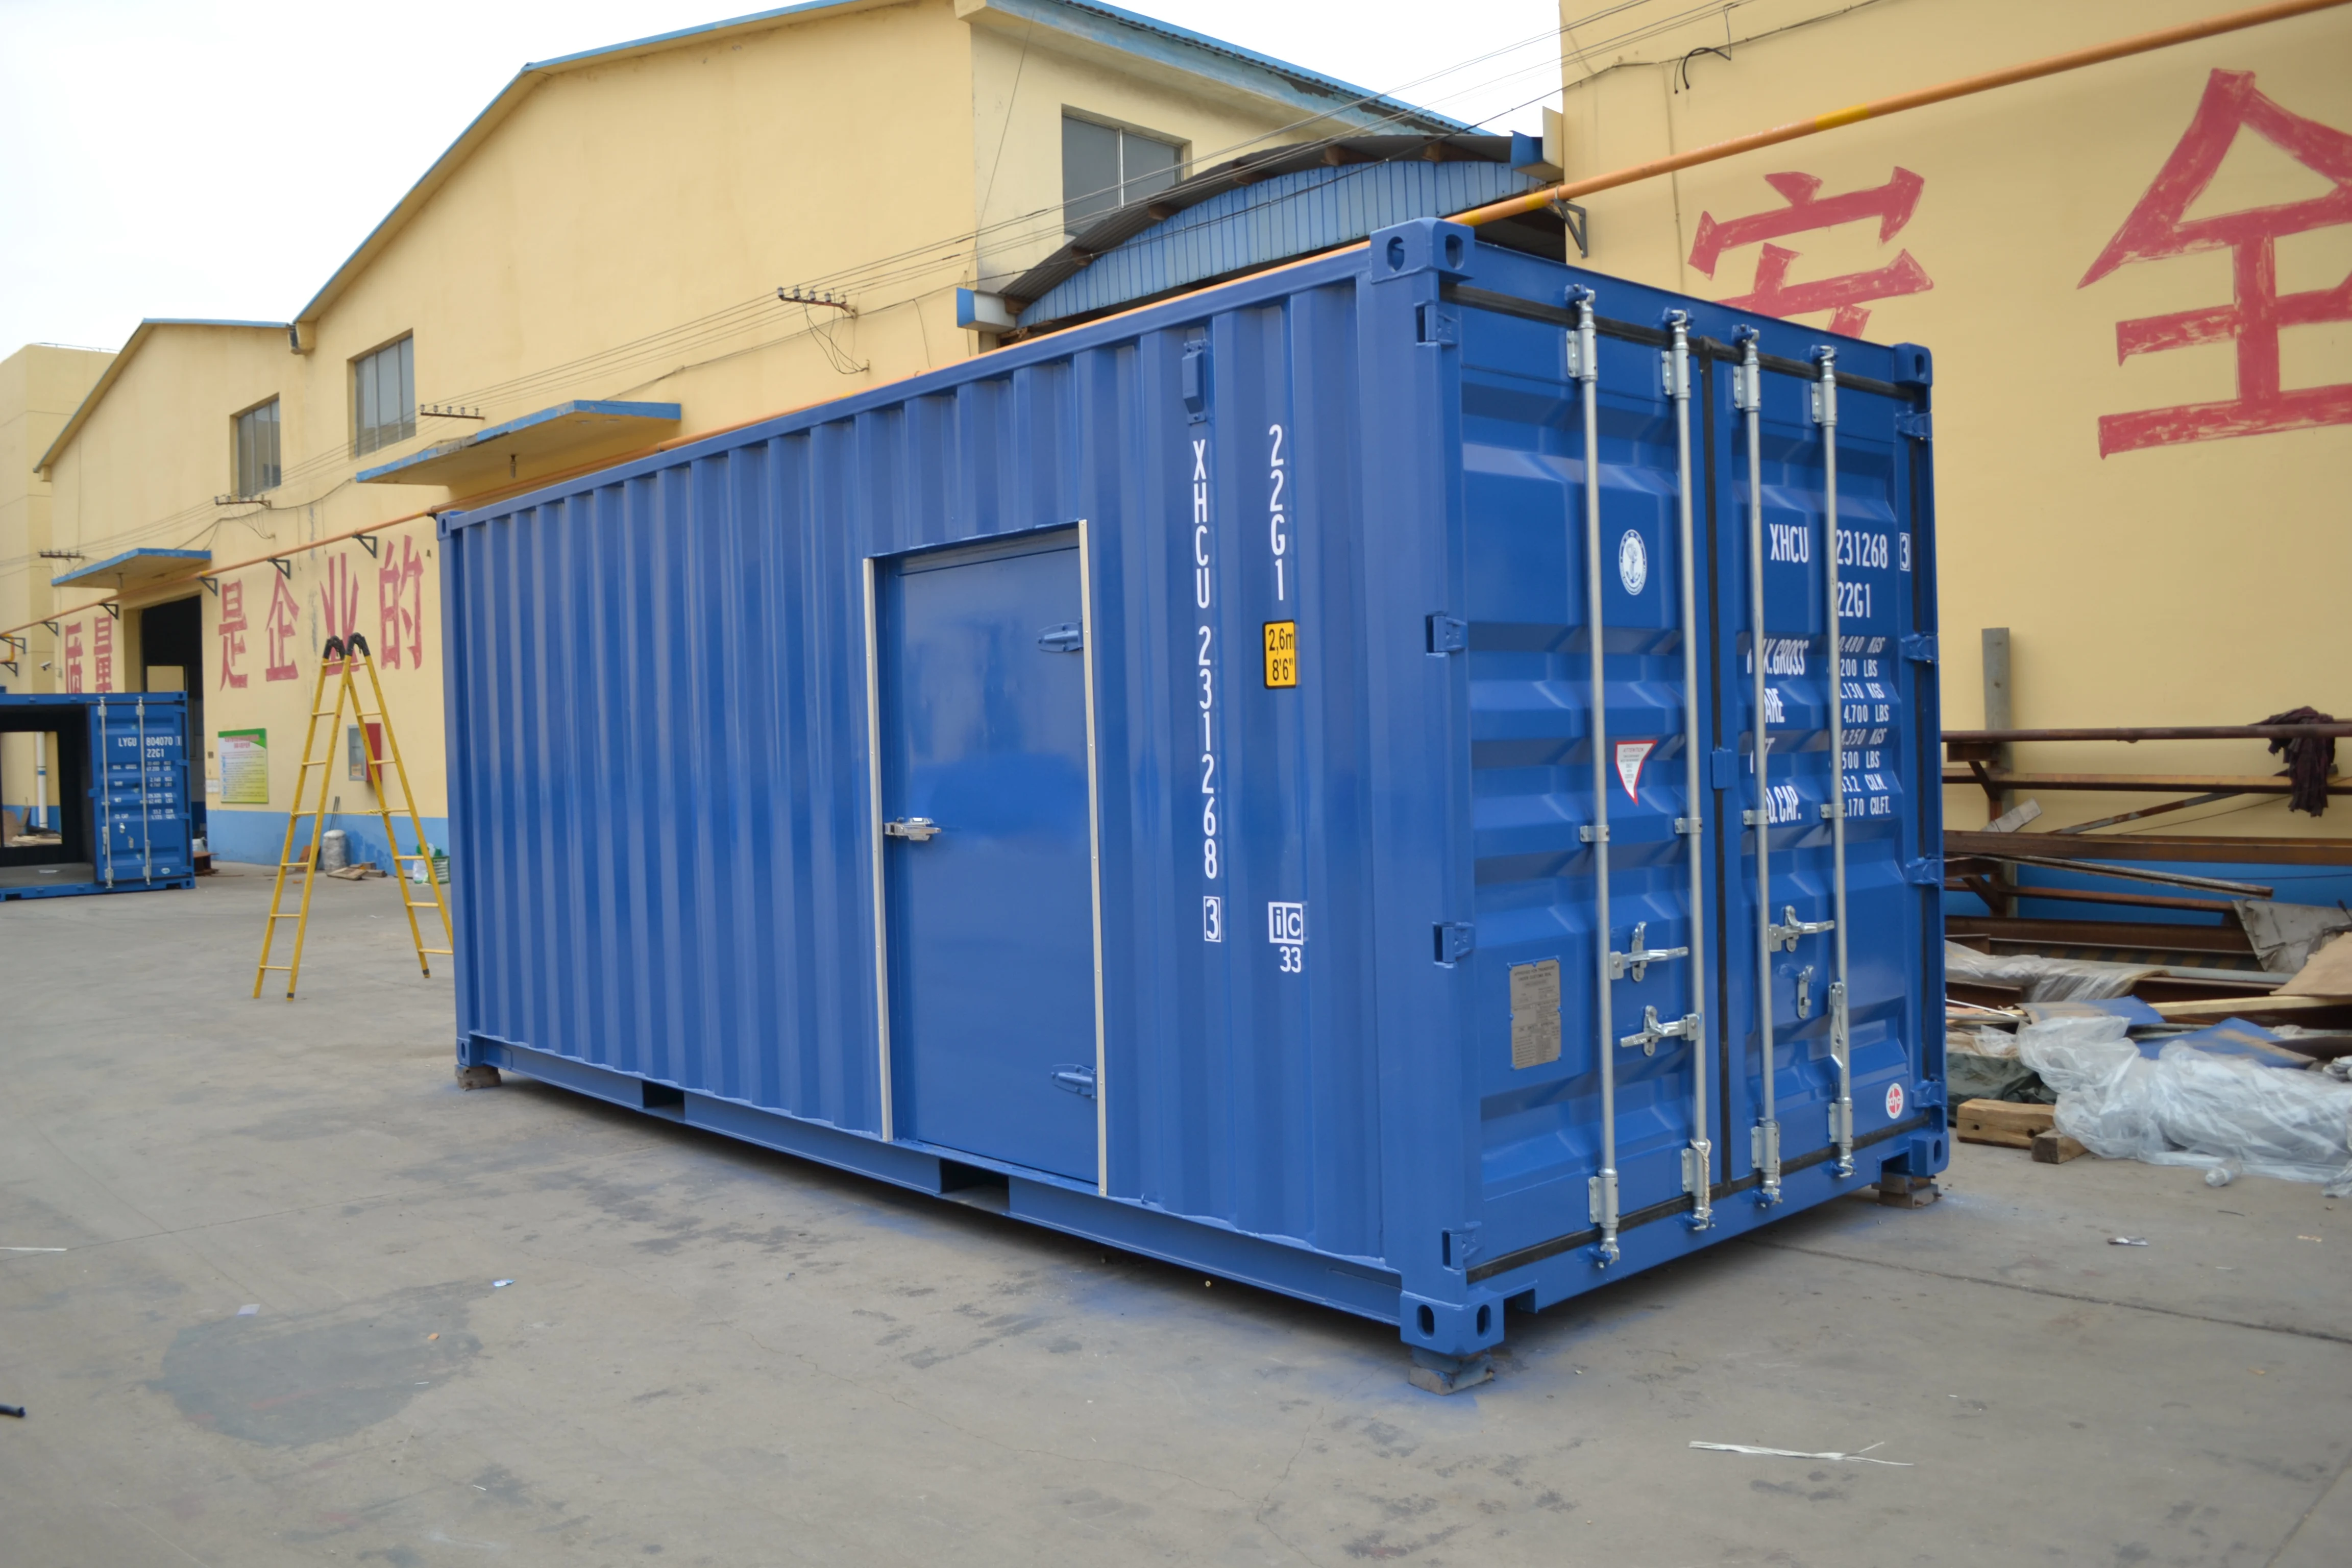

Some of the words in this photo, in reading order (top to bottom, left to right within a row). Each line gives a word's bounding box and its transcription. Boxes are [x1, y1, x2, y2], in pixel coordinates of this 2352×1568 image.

[1193, 439, 1210, 608] XHCU
[1269, 424, 1286, 600] 22G1
[1769, 523, 1808, 563] XHCU
[1836, 529, 1888, 569] 231268
[1900, 534, 1909, 570] 3
[1838, 581, 1870, 618] 22G1
[1747, 639, 1809, 675] X.GROSS
[1839, 636, 1865, 652] 0.480
[1867, 637, 1885, 653] KGS
[1864, 659, 1877, 677] LBS
[1765, 688, 1785, 723] ARE
[1866, 682, 1885, 699] KGS
[1844, 704, 1868, 723] 4.700
[1875, 704, 1890, 722] LBS
[146, 736, 173, 746] 804070
[146, 748, 164, 757] 22G1
[1198, 626, 1217, 879] 231268
[1841, 729, 1867, 745] 8.350
[1869, 728, 1888, 745] KGS
[1866, 751, 1880, 768] LBS
[1766, 785, 1801, 823] U.CAP.
[1205, 898, 1219, 940] 3
[1280, 946, 1302, 973] 33
